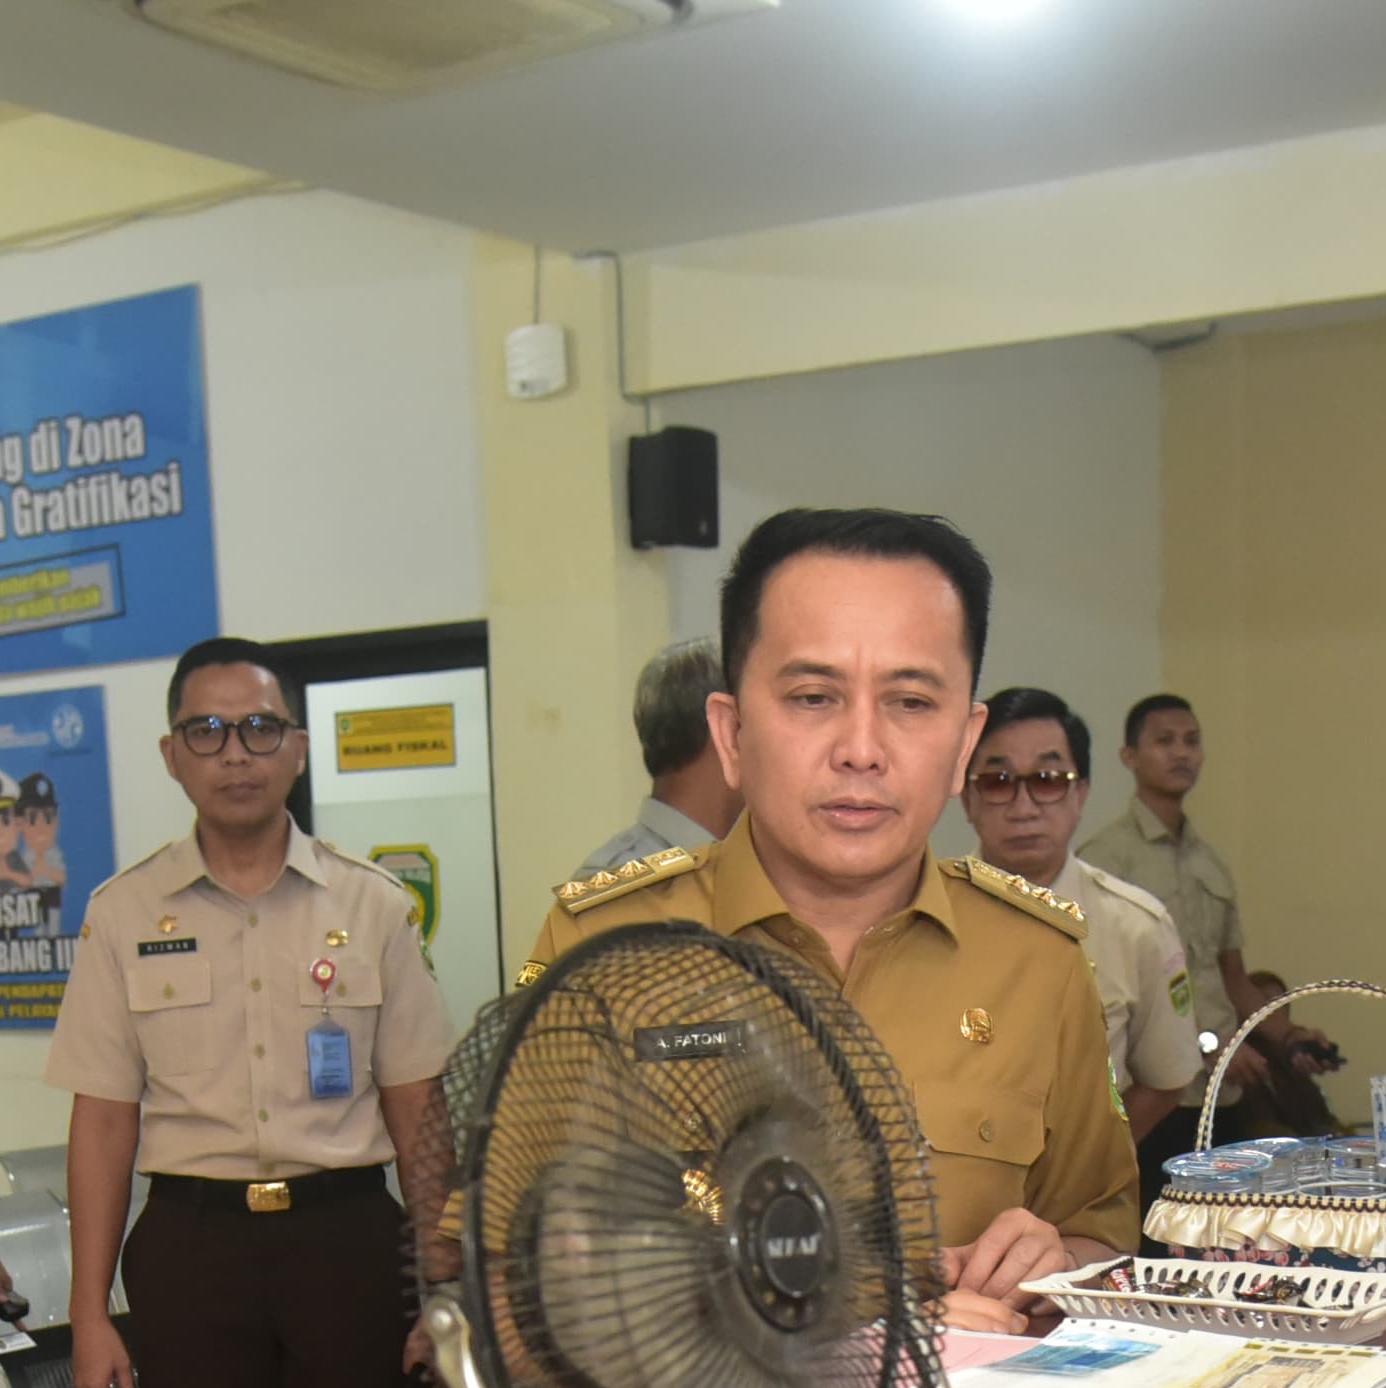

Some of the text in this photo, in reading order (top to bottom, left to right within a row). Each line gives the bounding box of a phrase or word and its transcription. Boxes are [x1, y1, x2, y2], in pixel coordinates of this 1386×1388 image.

[29, 421, 61, 474] di
[65, 412, 145, 465] Zona
[11, 462, 182, 537] Gratifikasi
[656, 1031, 727, 1049] A. FATONI
